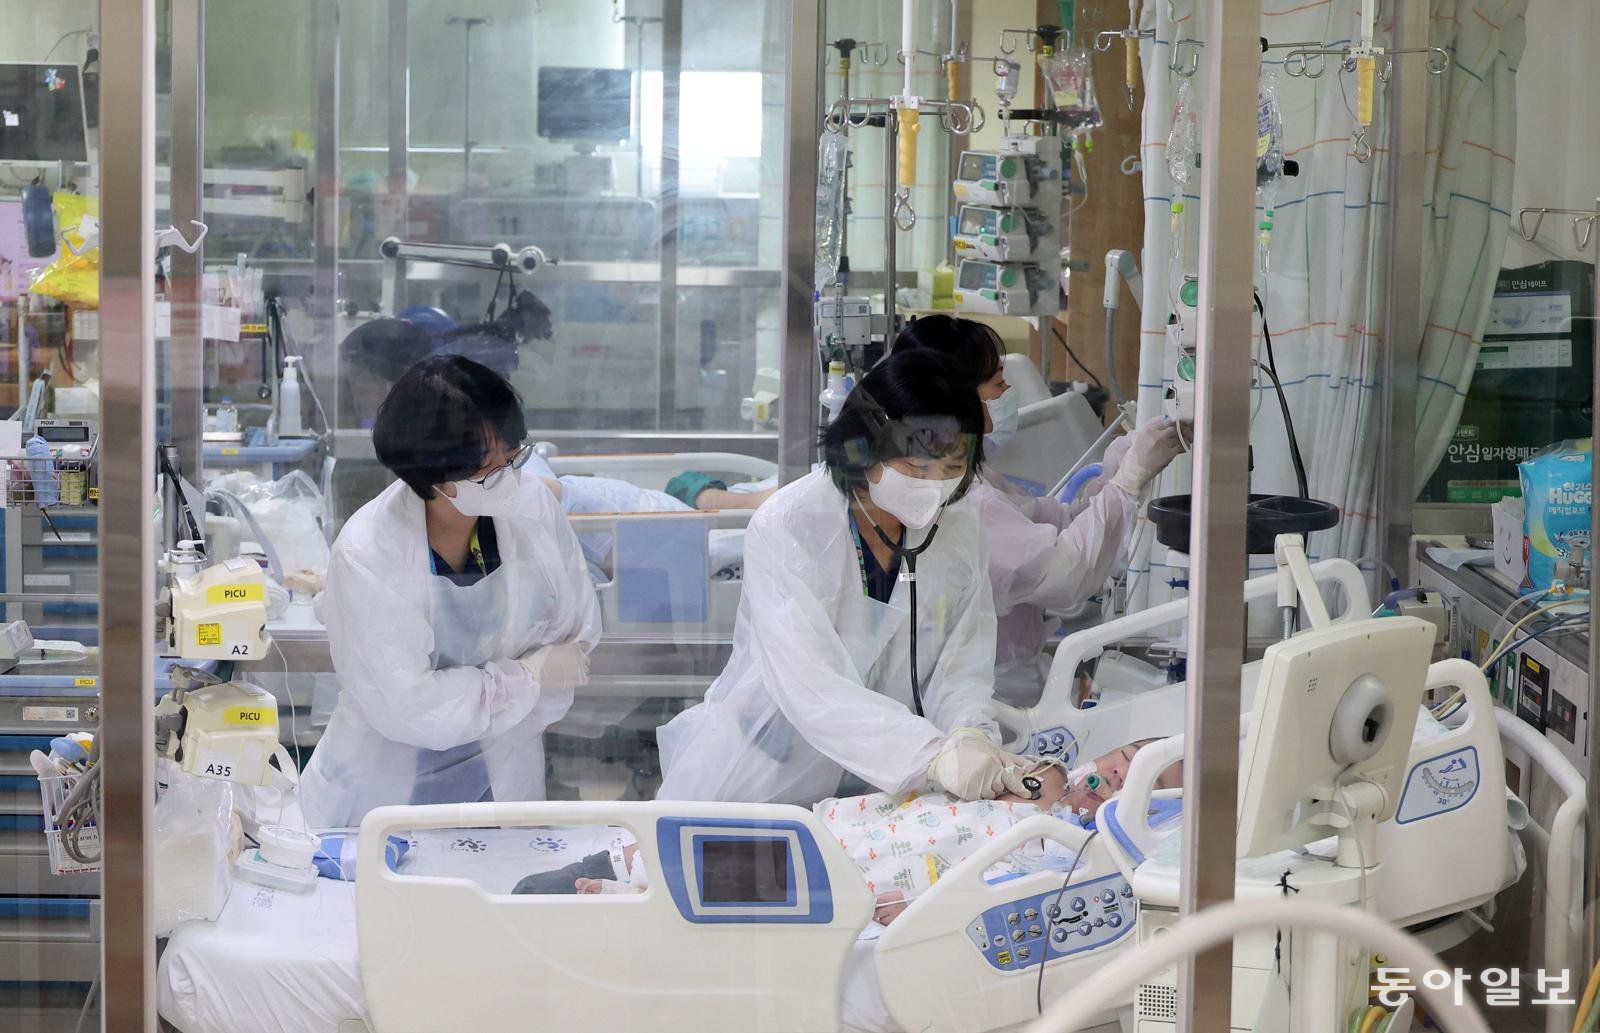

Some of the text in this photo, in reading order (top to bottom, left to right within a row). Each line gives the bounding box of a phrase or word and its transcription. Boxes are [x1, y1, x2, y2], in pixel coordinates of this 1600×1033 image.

[1448, 443, 1480, 463] 안심
[224, 589, 246, 598] PICU
[231, 645, 249, 655] A2
[240, 712, 261, 721] PICU
[205, 763, 232, 777] A35
